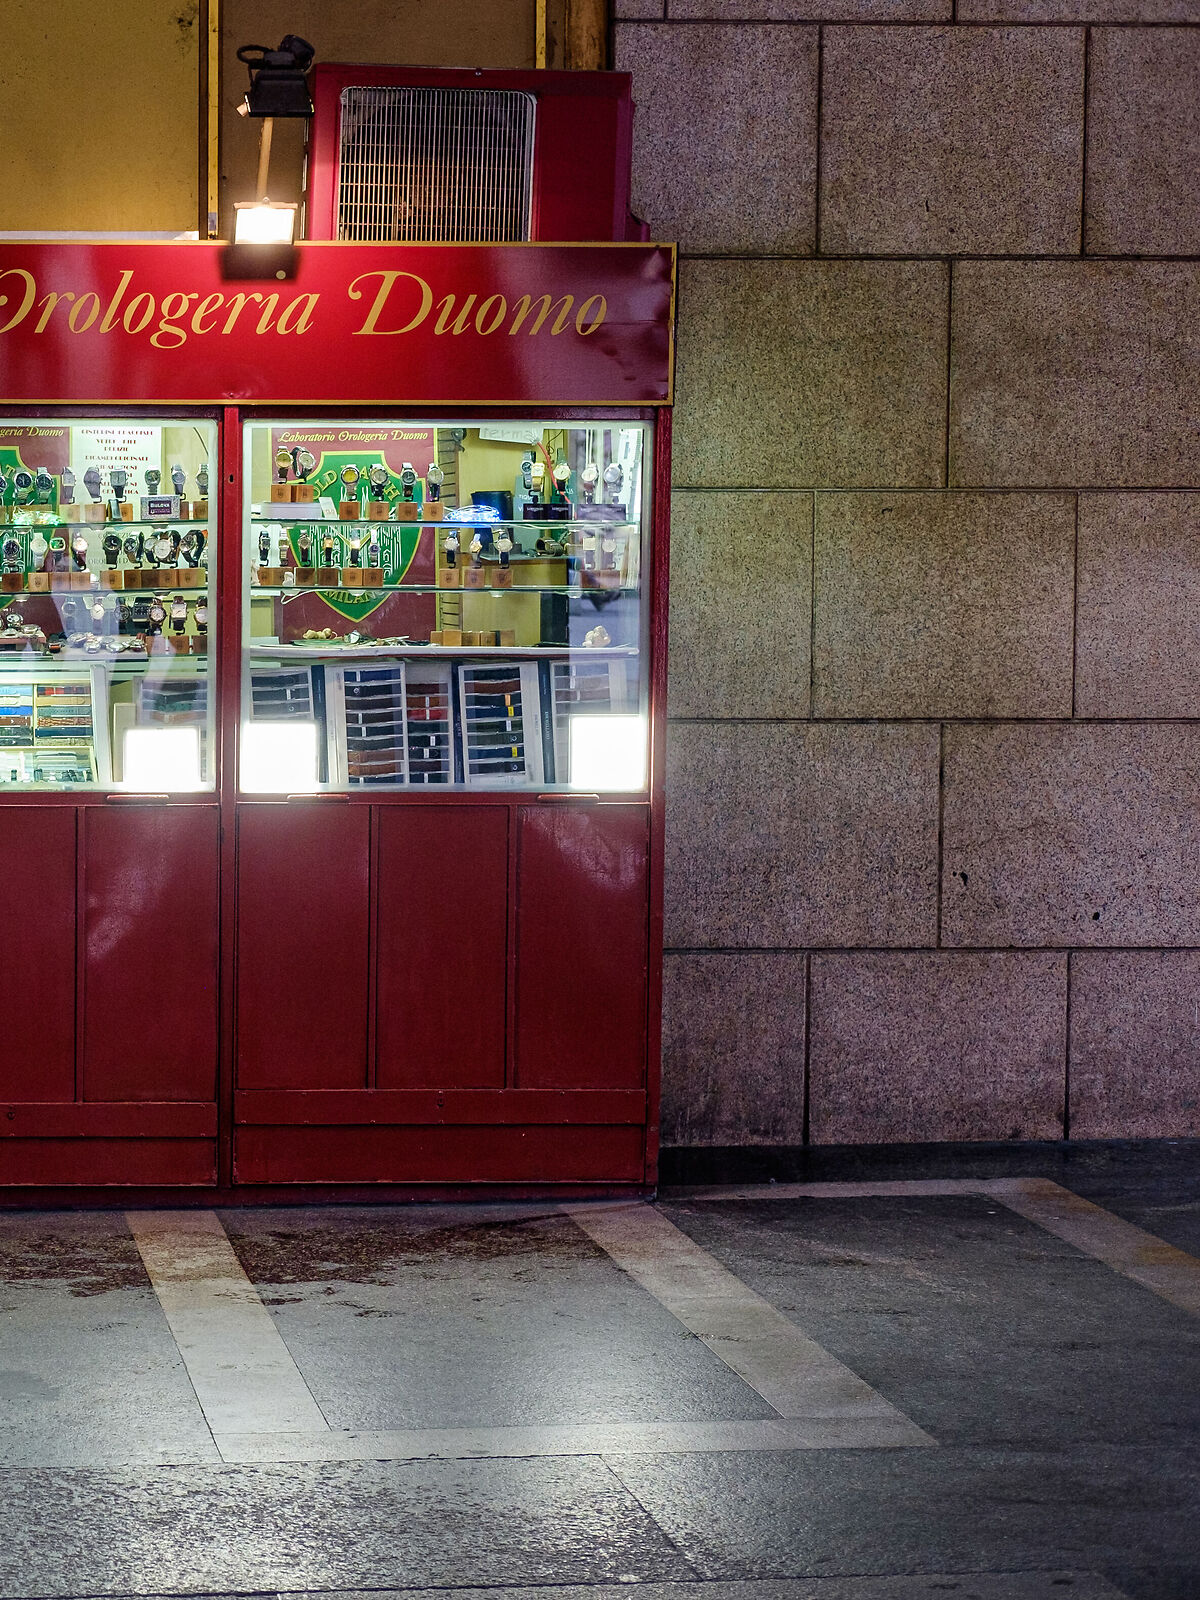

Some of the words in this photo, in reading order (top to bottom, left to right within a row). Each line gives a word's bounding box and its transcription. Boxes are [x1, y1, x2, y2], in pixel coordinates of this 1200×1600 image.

[348, 270, 607, 336] Duomo
[26, 426, 64, 437] Duomo
[277, 431, 335, 442] Laboratorio
[338, 430, 388, 442] Orologeria
[390, 429, 428, 441] Duomo
